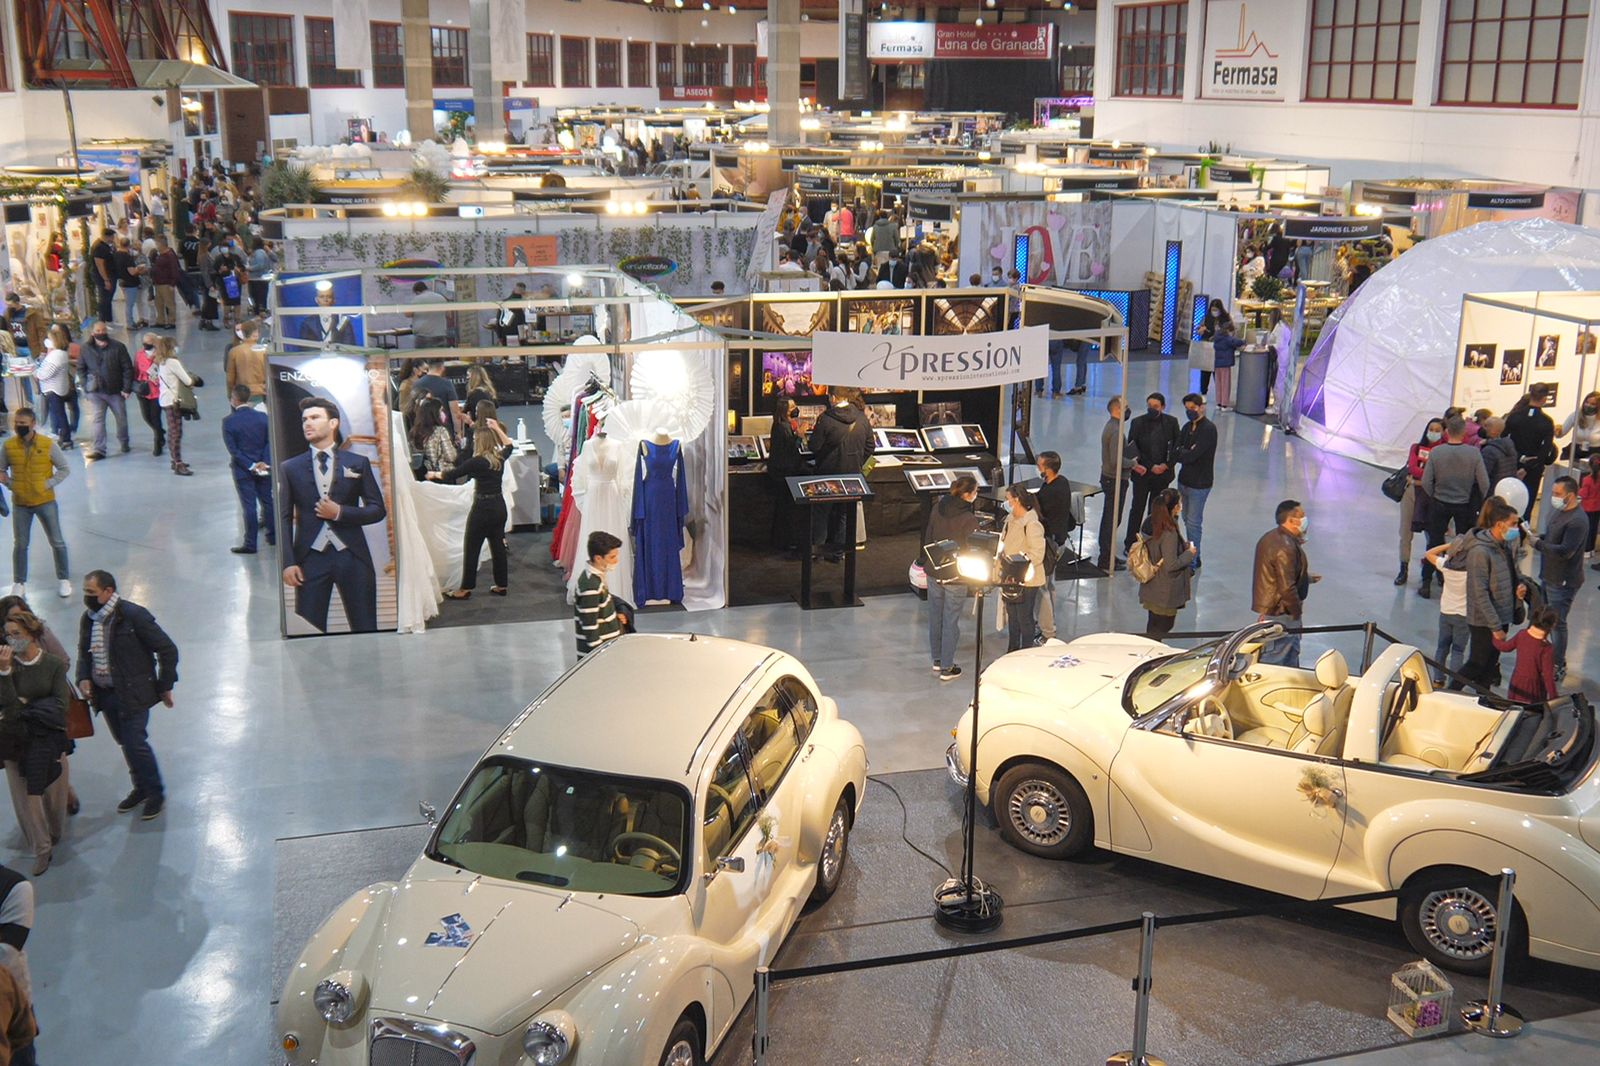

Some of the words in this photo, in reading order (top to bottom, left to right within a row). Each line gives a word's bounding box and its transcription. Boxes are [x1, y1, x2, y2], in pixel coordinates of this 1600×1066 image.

[937, 30, 953, 38] Gran
[956, 30, 977, 38] Hotel
[880, 43, 923, 53] Fermasa
[937, 38, 968, 50] Luna
[971, 38, 988, 50] de
[991, 38, 1046, 50] Granada
[1213, 60, 1278, 86] Fermasa
[686, 88, 708, 96] ASEOS
